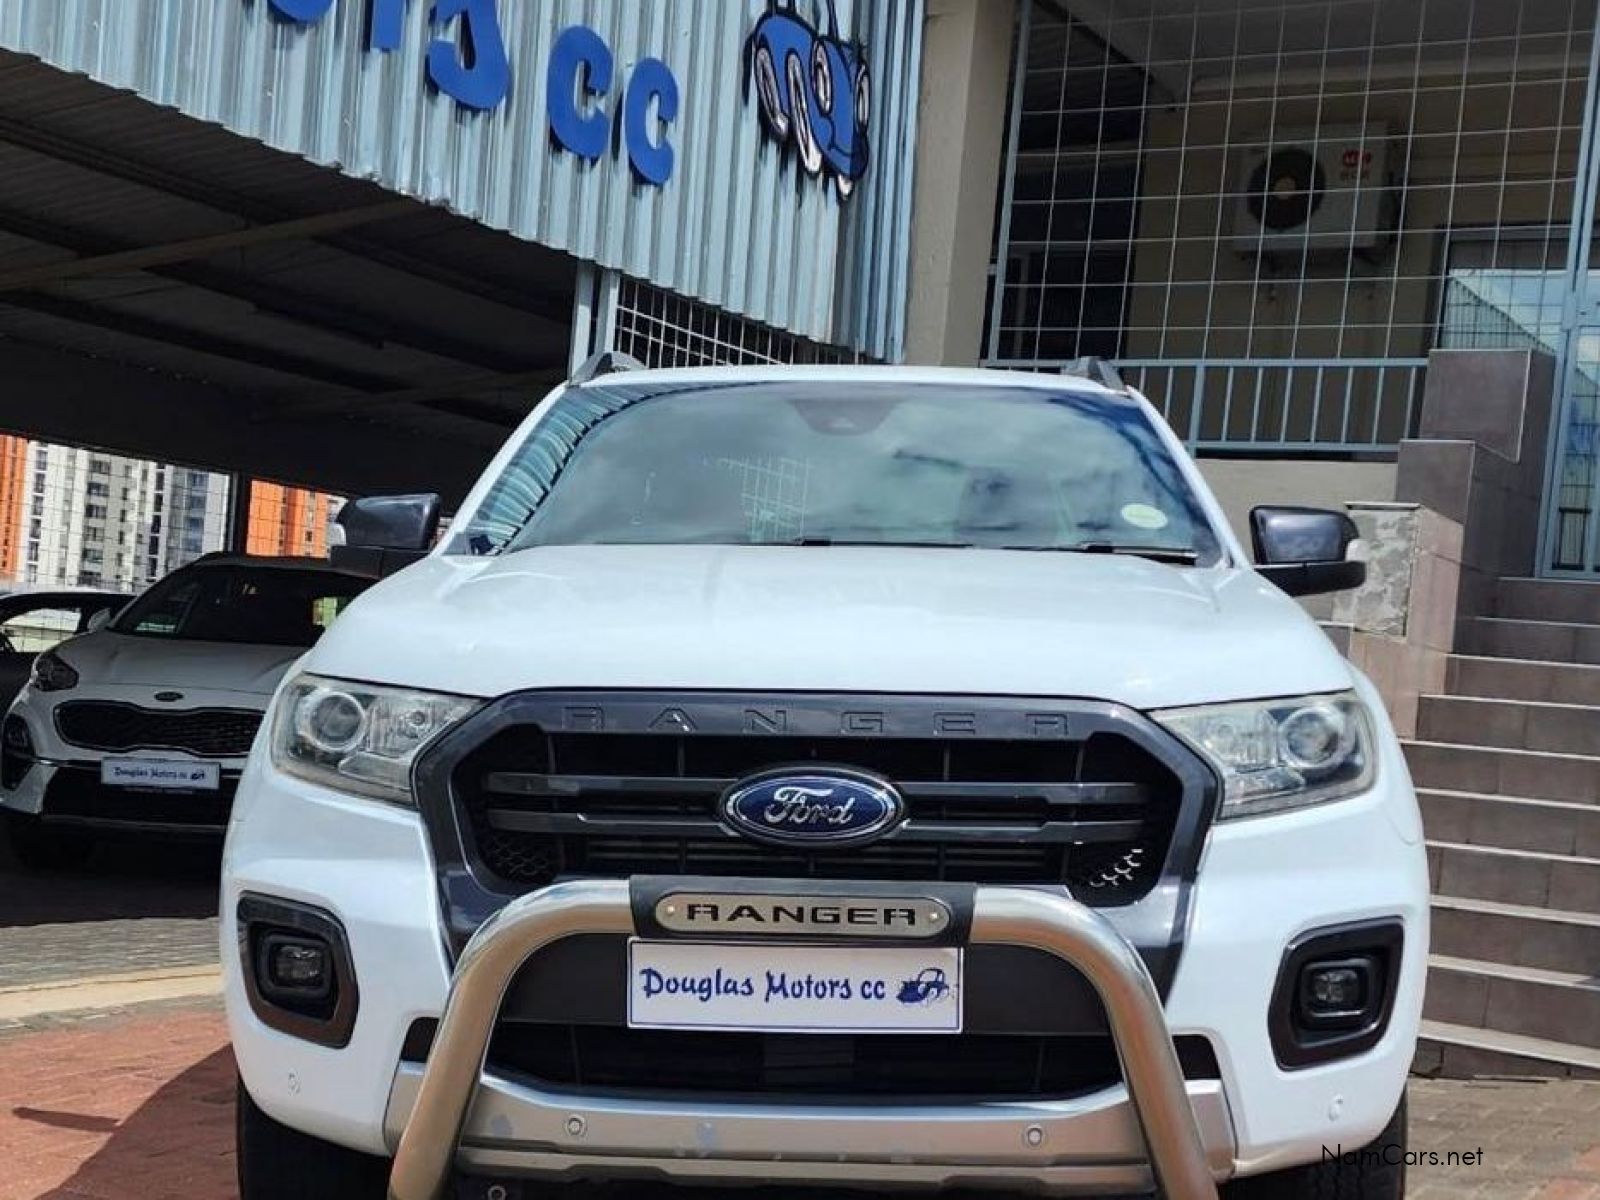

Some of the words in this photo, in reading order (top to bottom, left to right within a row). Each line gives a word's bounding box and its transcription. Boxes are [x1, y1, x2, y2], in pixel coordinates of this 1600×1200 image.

[561, 706, 1069, 736] RANGER
[764, 786, 855, 825] Ford
[686, 903, 916, 926] RANGER
[639, 967, 754, 1002] Douglas
[764, 970, 852, 1003] Motors
[860, 982, 887, 1000] cc
